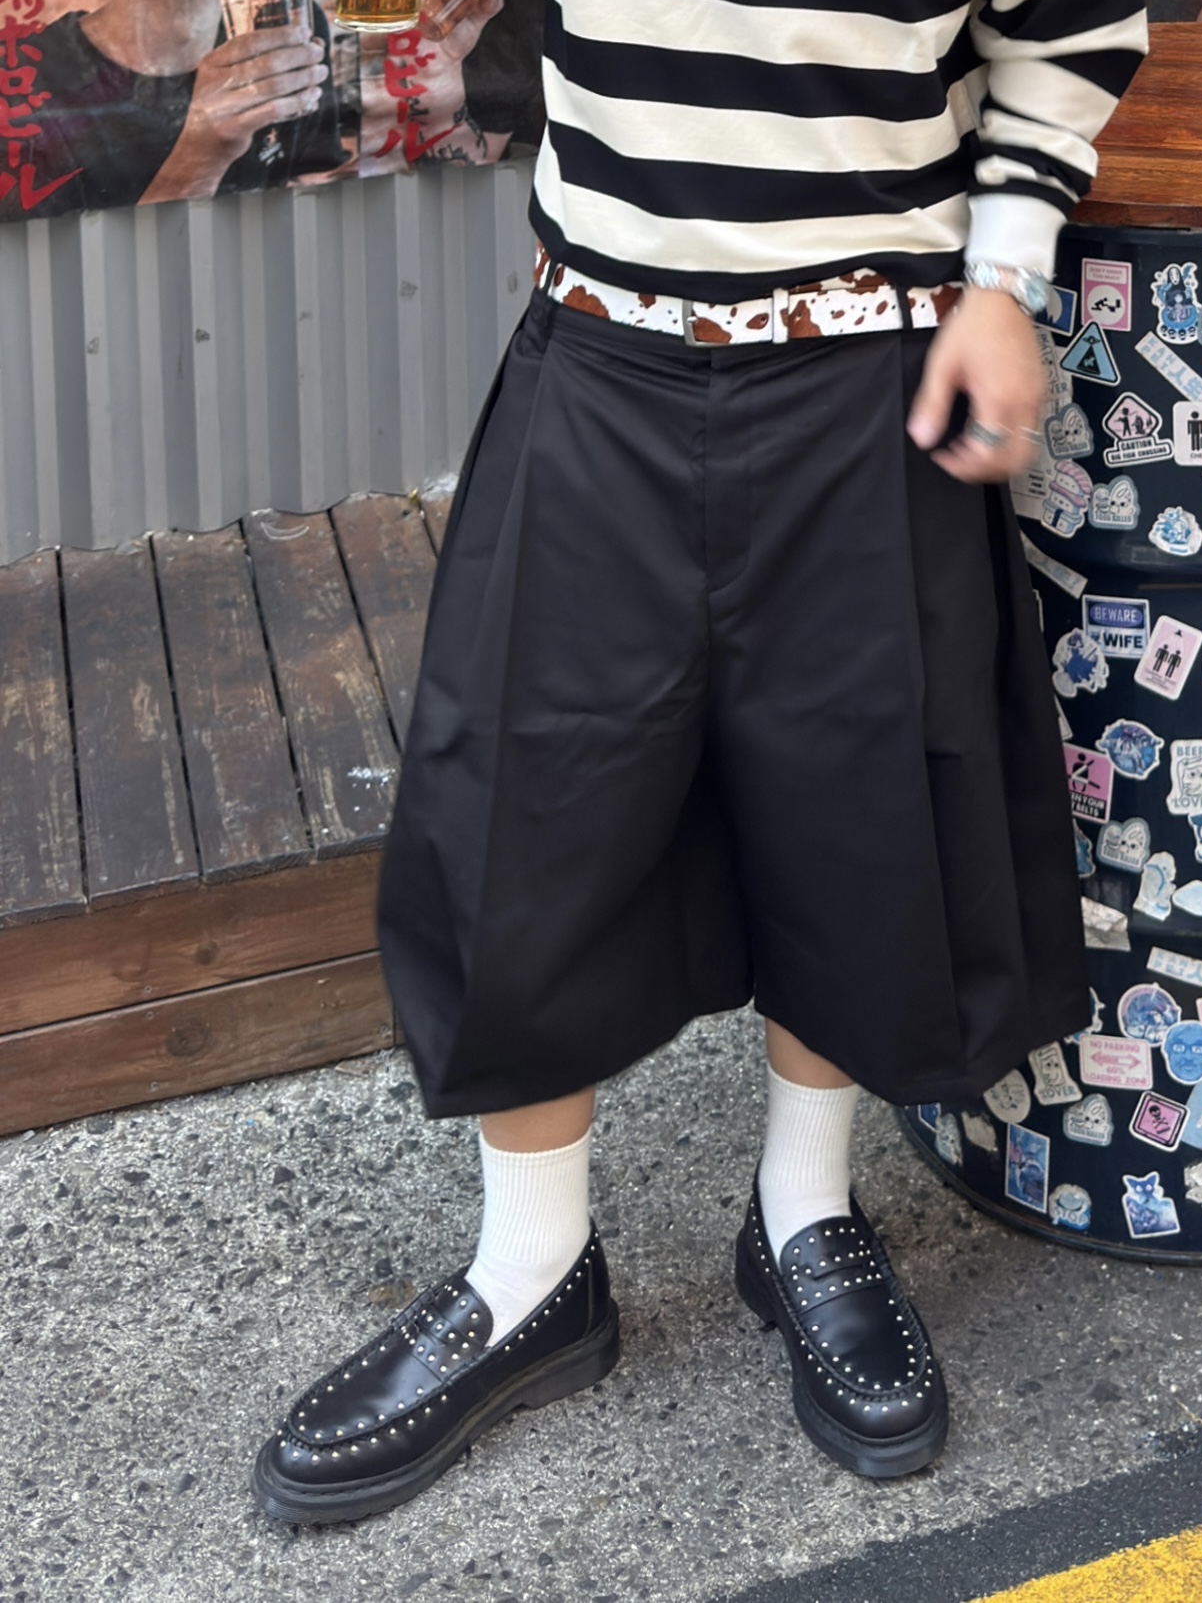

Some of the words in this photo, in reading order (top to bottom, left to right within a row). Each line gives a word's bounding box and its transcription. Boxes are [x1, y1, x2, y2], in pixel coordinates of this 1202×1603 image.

[1121, 438, 1153, 451] CAUTION
[1094, 606, 1138, 623] BEWARE
[1103, 633, 1143, 648] WIFE
